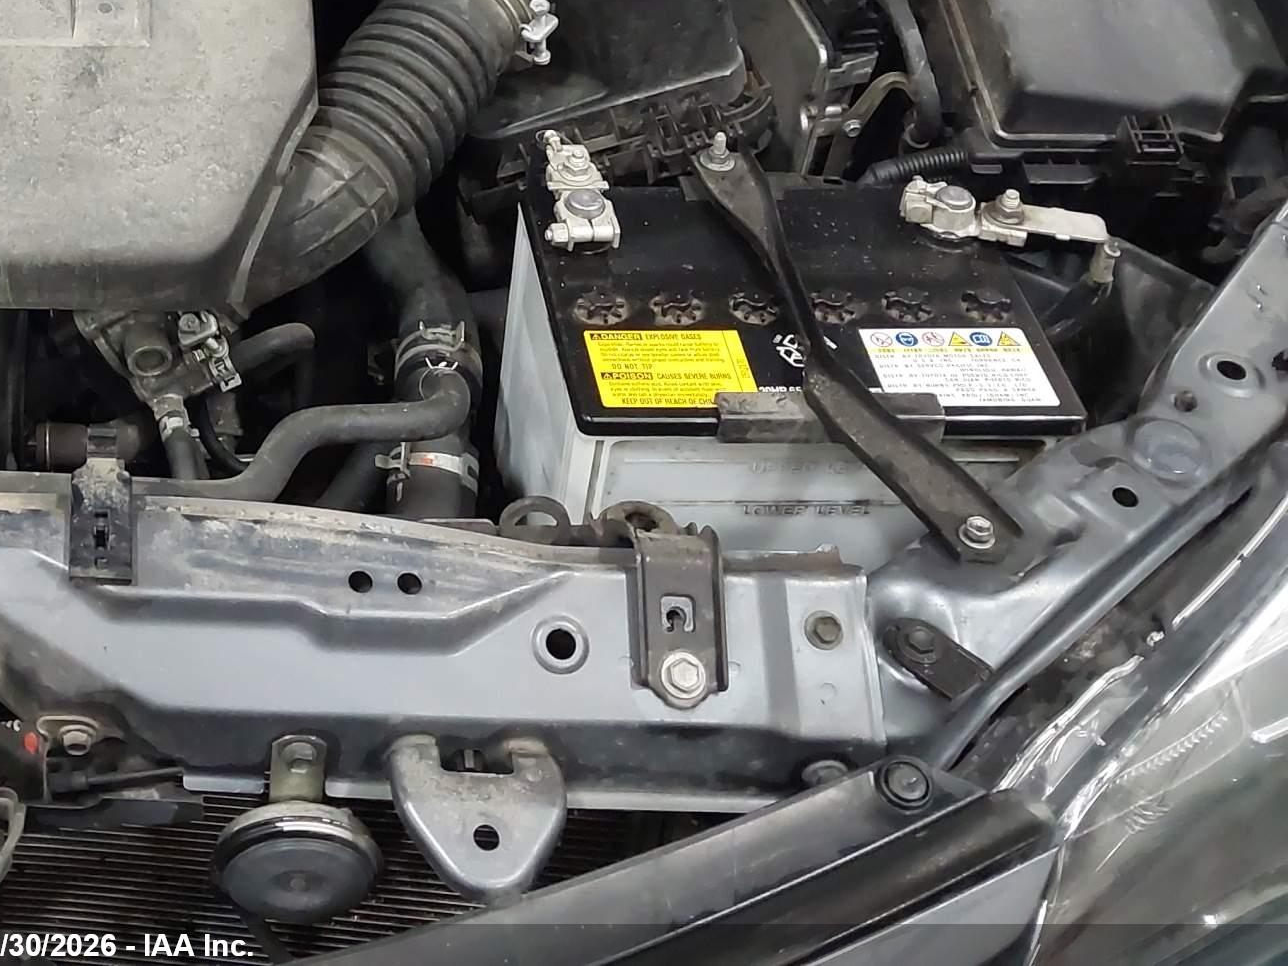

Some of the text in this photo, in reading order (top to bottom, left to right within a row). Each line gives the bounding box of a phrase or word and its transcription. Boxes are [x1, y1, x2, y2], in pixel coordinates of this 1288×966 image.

[612, 372, 652, 380] POISON
[743, 505, 871, 515] LOWER LEVEL
